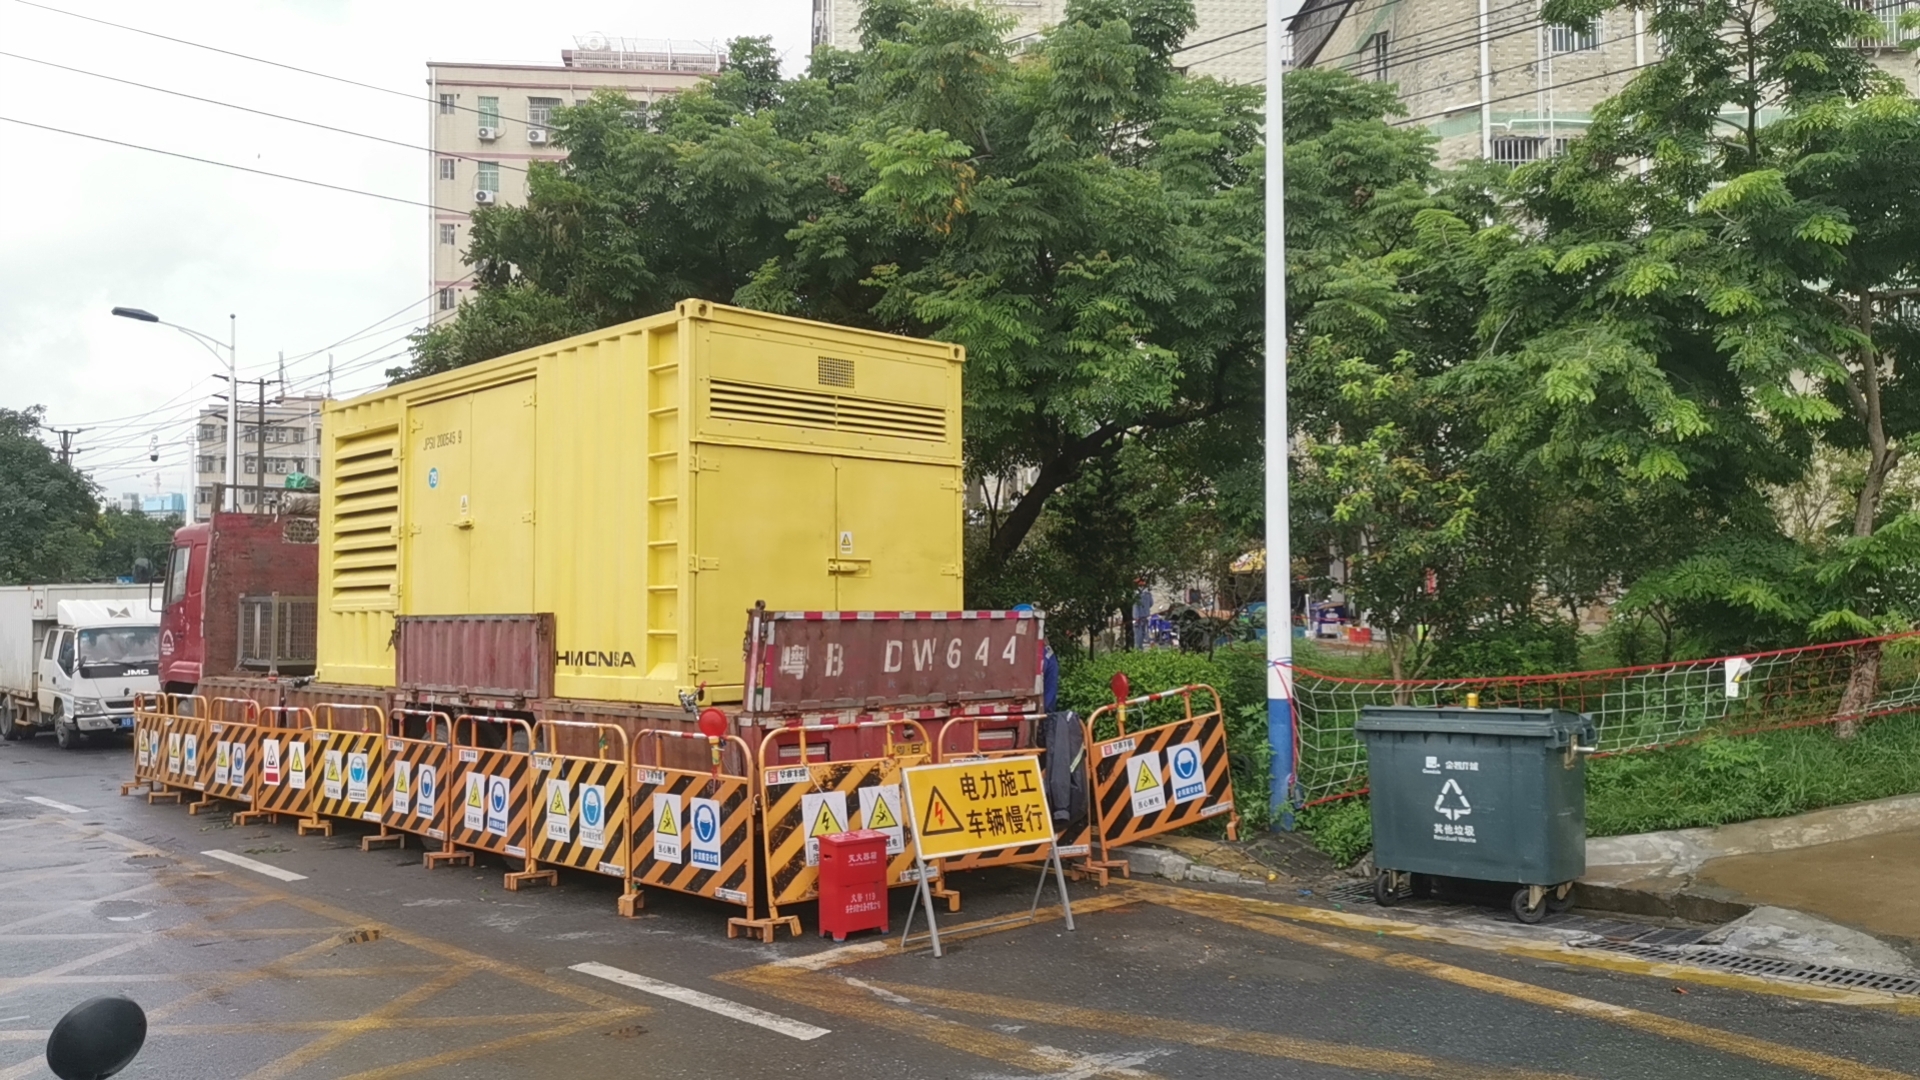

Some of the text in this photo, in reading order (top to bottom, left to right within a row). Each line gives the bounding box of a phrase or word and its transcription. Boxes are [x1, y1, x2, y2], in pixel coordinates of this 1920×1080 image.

[123, 668, 149, 676] JMC
[960, 769, 1037, 801] 电力施工
[1137, 796, 1160, 810] 当心触电
[966, 803, 1043, 839] 车辆慢行
[1433, 823, 1475, 836] 其他垃圾
[658, 843, 677, 856] 当心触电
[848, 851, 877, 863] 灭火器箱
